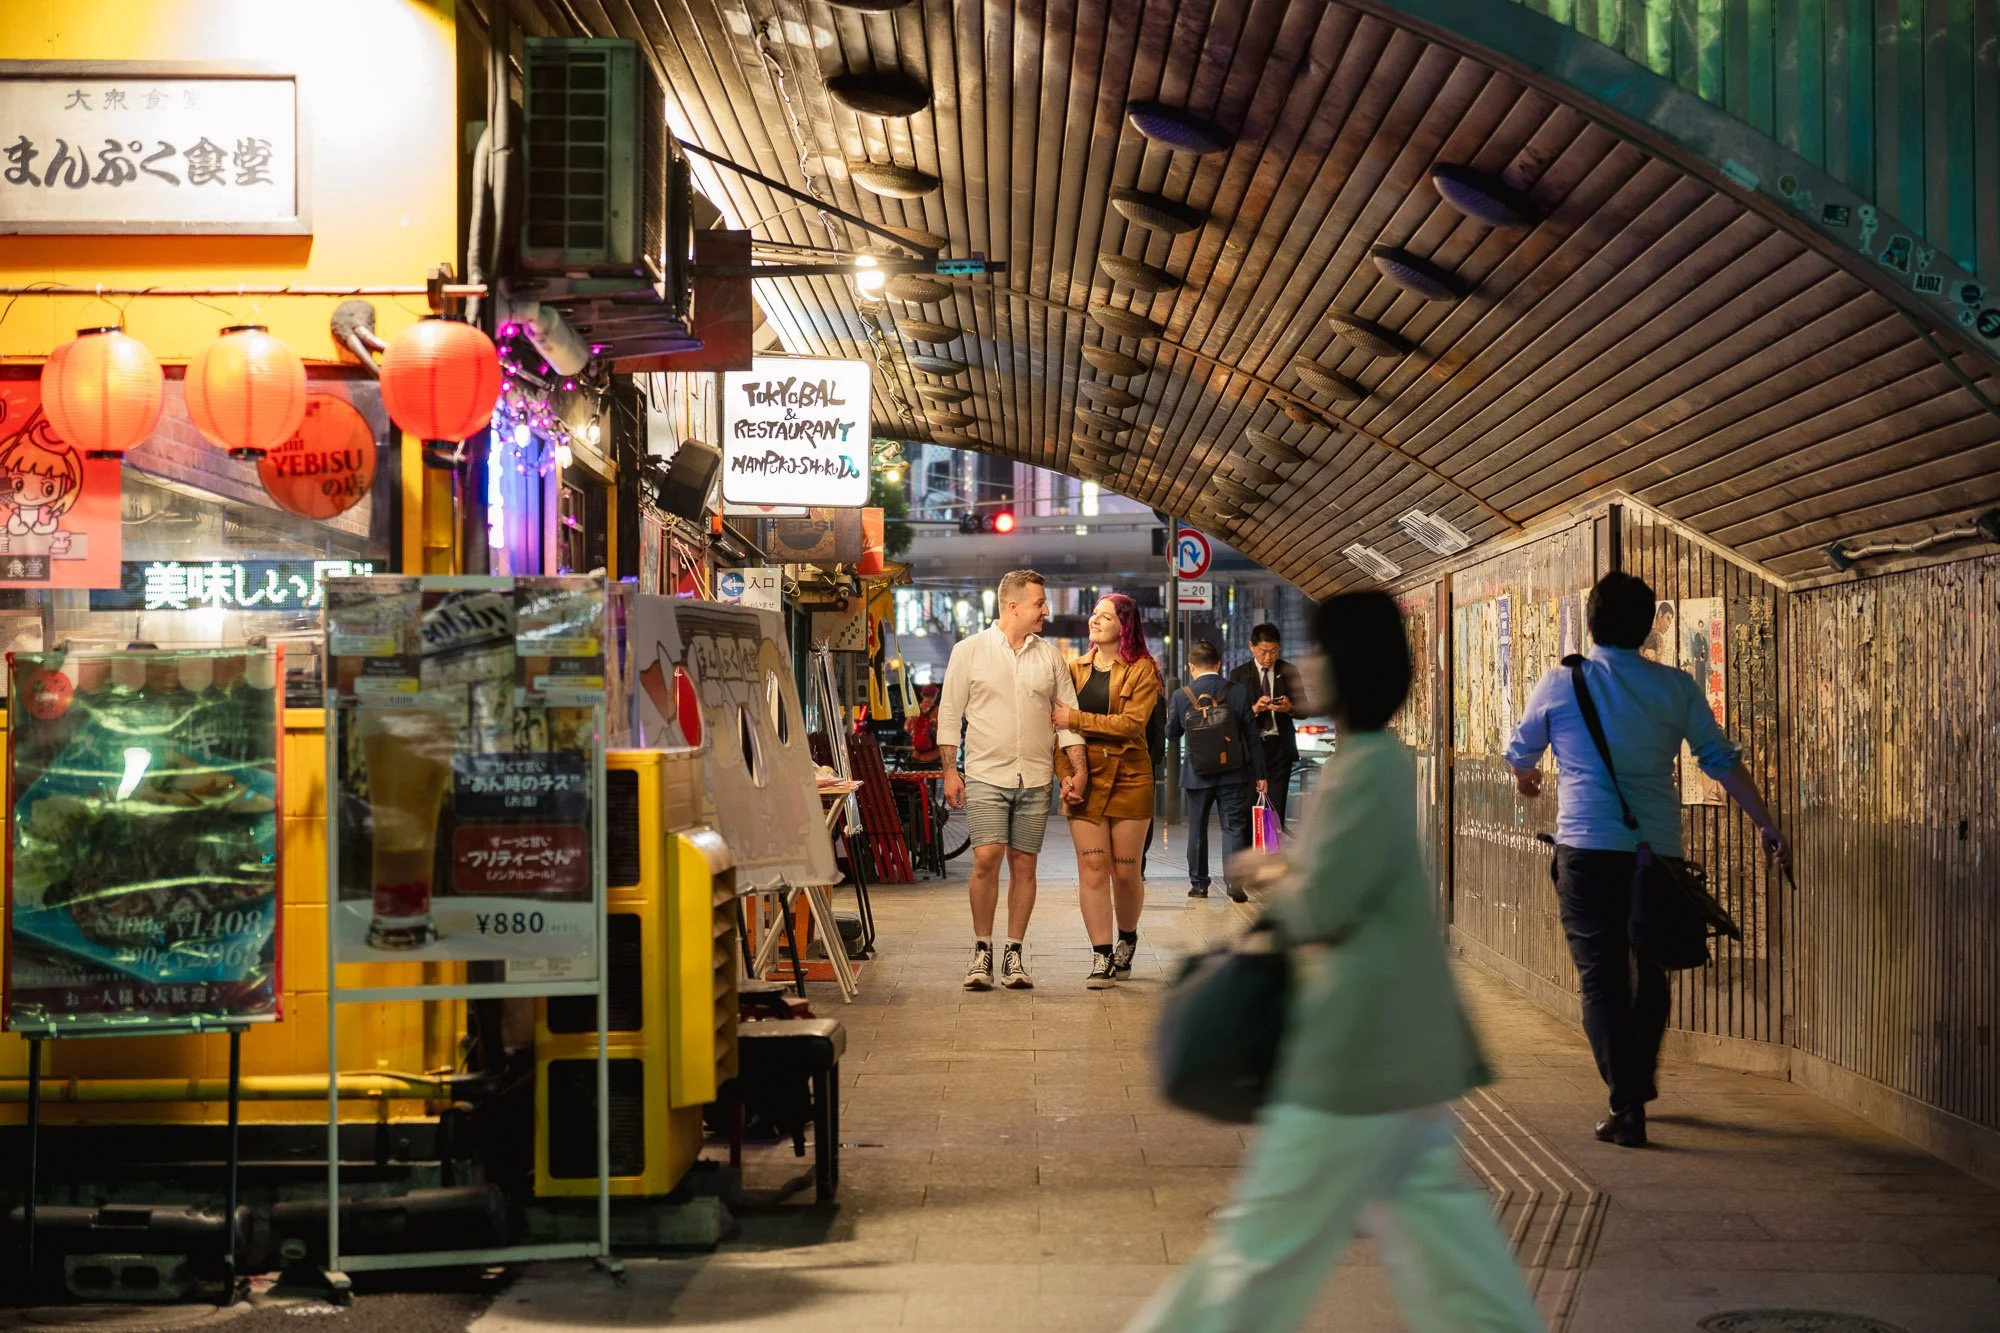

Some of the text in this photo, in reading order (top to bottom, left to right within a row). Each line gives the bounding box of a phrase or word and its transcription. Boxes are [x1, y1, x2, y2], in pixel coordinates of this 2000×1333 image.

[3, 135, 274, 190] まんぷく食堂
[783, 408, 800, 421] &
[733, 417, 856, 449] RESTAURANT
[270, 448, 363, 478] YEBISU
[6, 558, 45, 578] 食堂
[748, 576, 775, 590] 入口
[475, 911, 544, 935] ¥880
